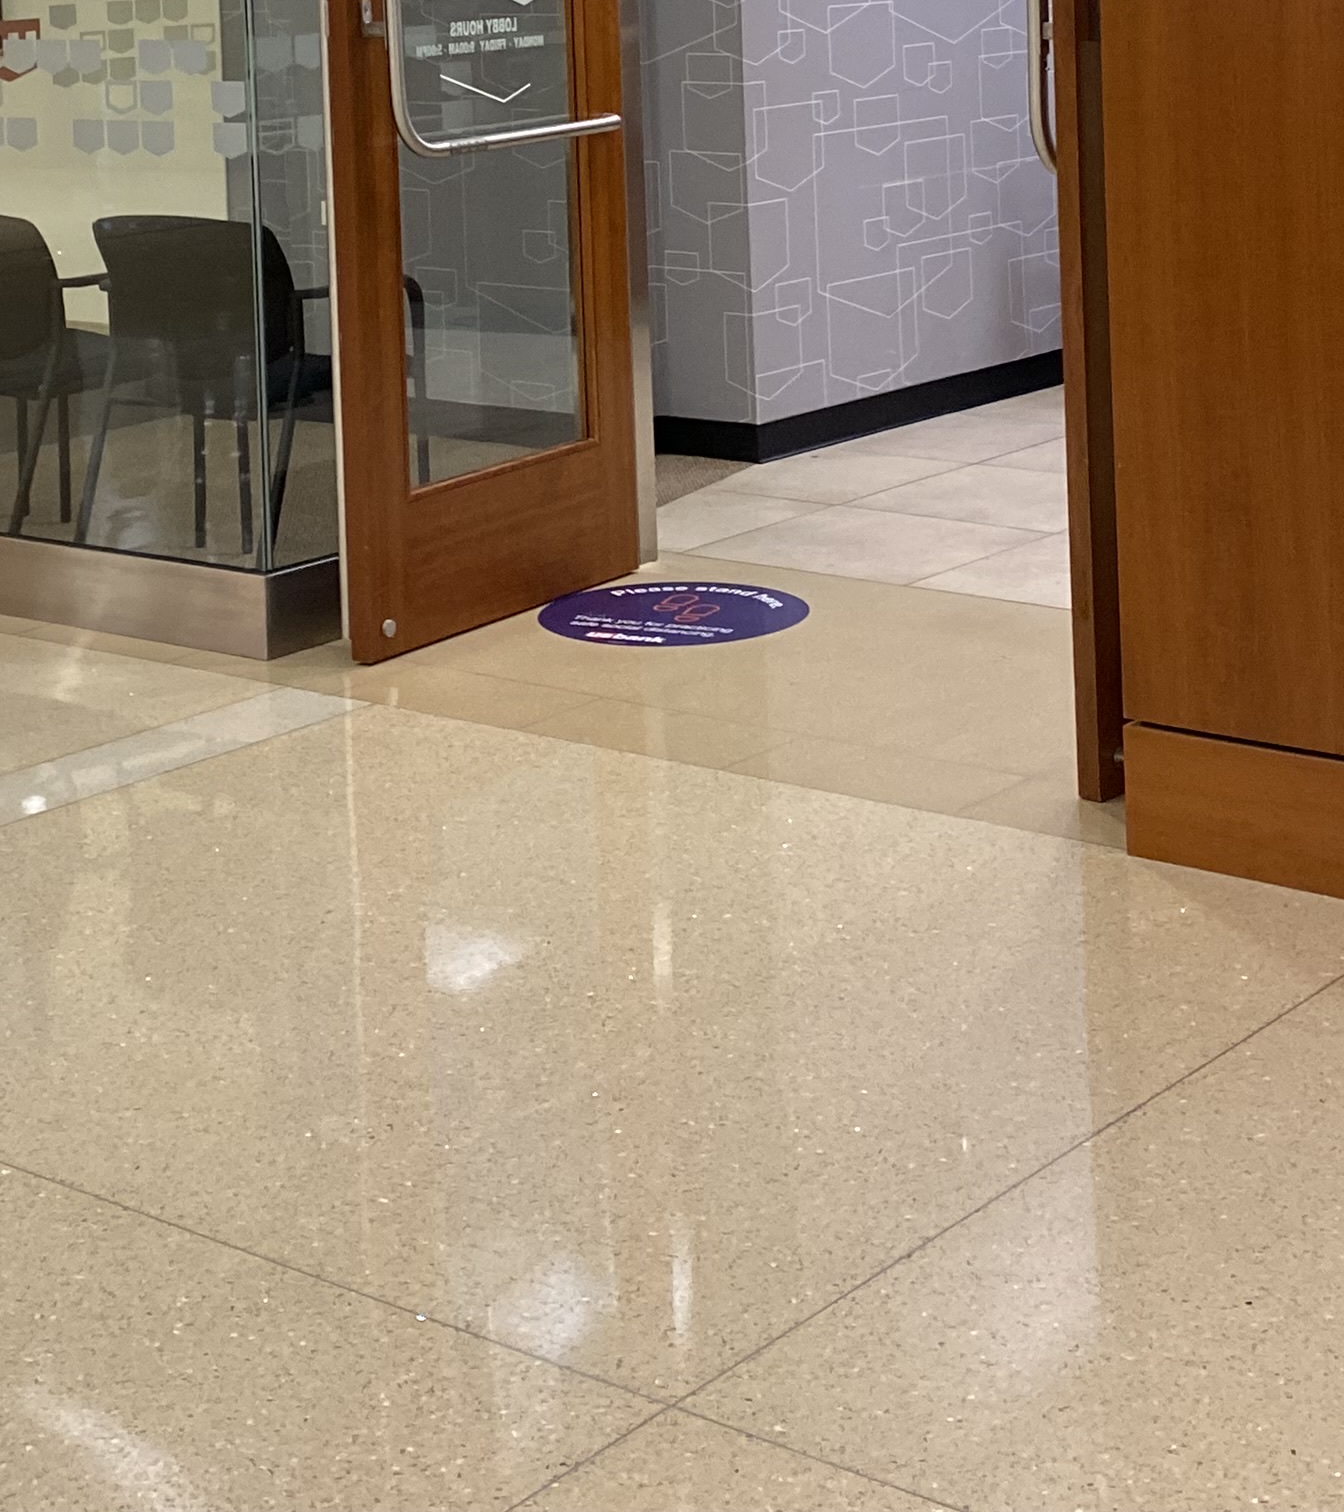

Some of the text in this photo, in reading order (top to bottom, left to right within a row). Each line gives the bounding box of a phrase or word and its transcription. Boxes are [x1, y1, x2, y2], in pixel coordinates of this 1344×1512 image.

[610, 586, 688, 596] Please
[695, 586, 758, 597] stand
[574, 614, 614, 623] Thank
[664, 623, 734, 634] practicing
[601, 623, 643, 631] social
